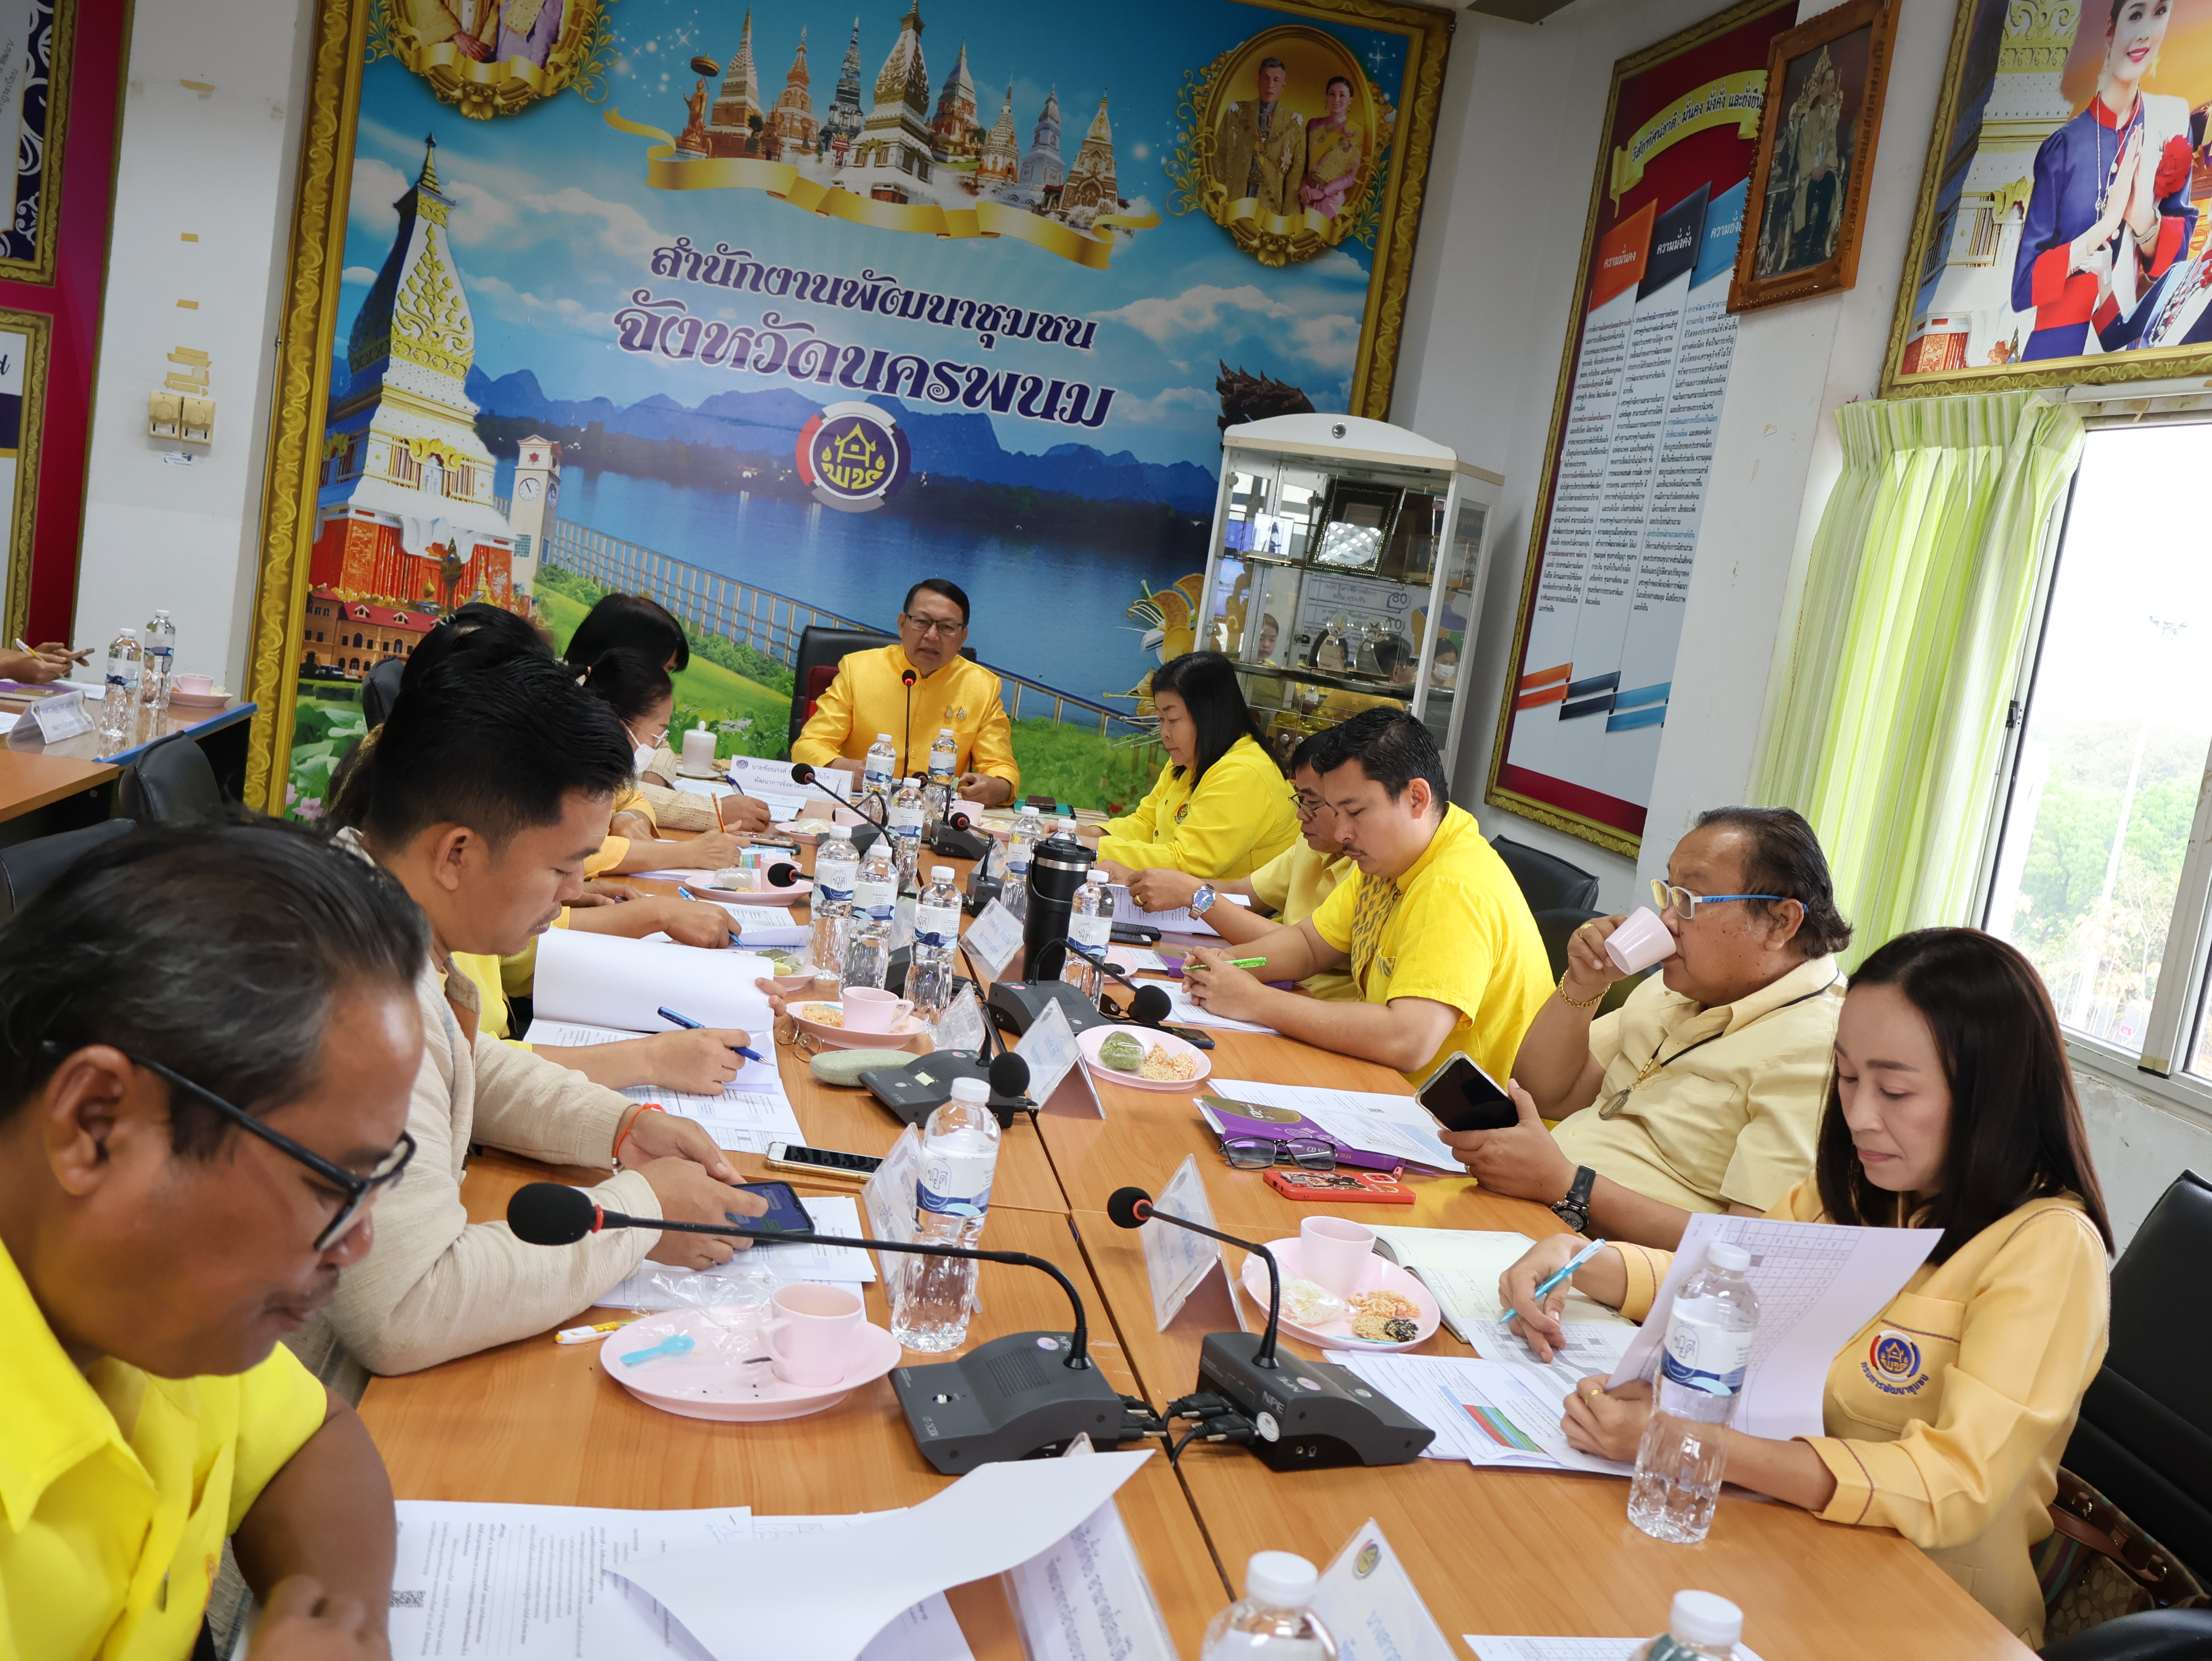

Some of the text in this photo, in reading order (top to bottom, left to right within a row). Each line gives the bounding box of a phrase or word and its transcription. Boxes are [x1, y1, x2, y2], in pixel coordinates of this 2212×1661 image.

[650, 236, 1099, 350] สำนักงานพัฒนาชุมชน
[1657, 225, 1692, 255] ความมั่งคั่ง
[614, 289, 1116, 429] จังหวัดนครพนม
